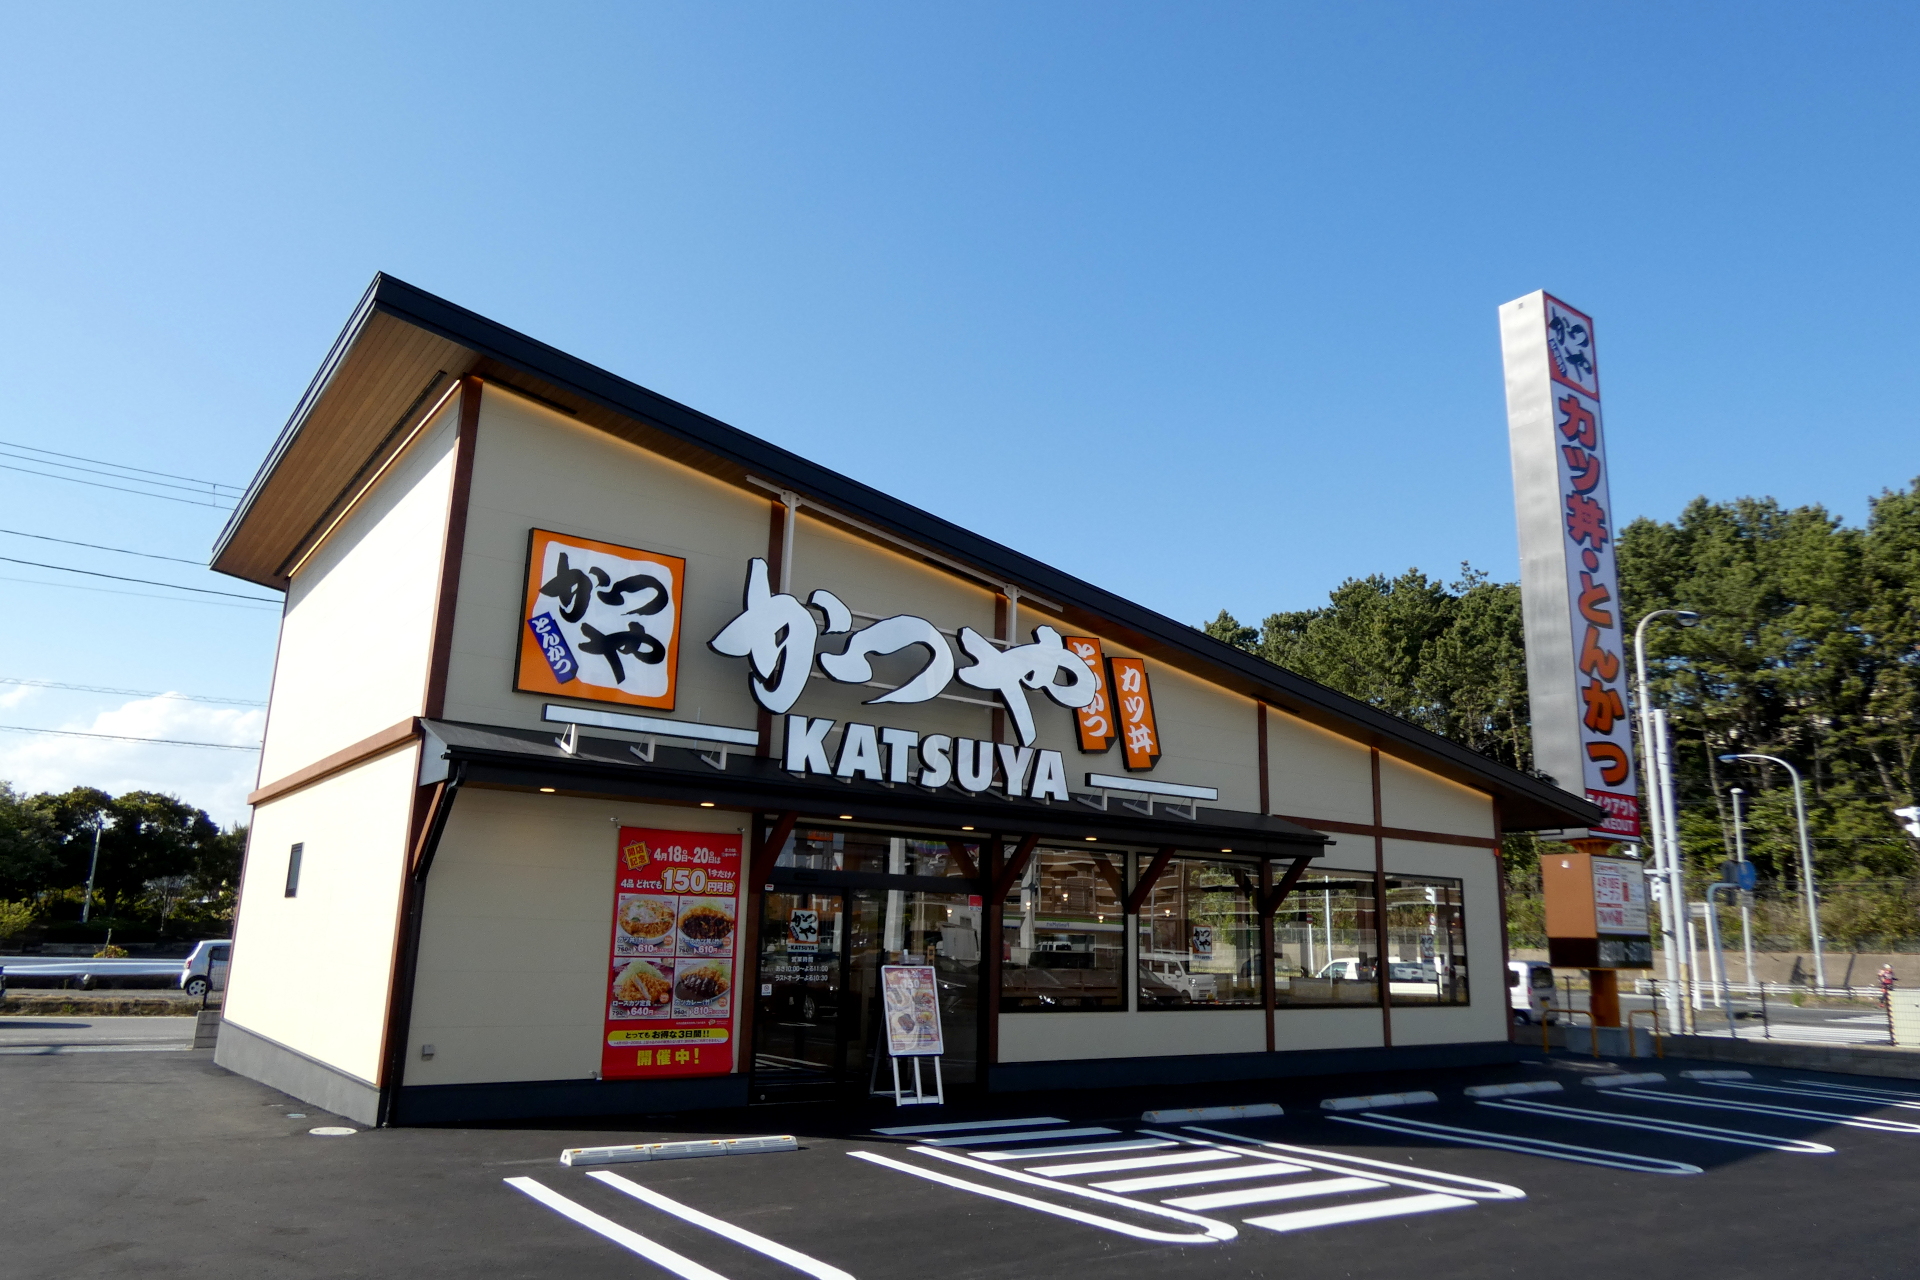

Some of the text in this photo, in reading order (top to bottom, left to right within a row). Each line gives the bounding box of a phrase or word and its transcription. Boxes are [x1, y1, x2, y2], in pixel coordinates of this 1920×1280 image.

[532, 617, 571, 674] とんかつ
[707, 557, 1097, 747] かつや
[1121, 666, 1154, 754] カツ丼
[784, 714, 1069, 801] KATSUYA
[1599, 818, 1634, 832] KEOUT
[627, 844, 644, 857] 開店
[630, 855, 648, 867] 記念
[636, 880, 662, 889] どれでも
[663, 869, 706, 892] 150
[706, 882, 734, 893] 円引き
[637, 1048, 699, 1066] 開催中!
